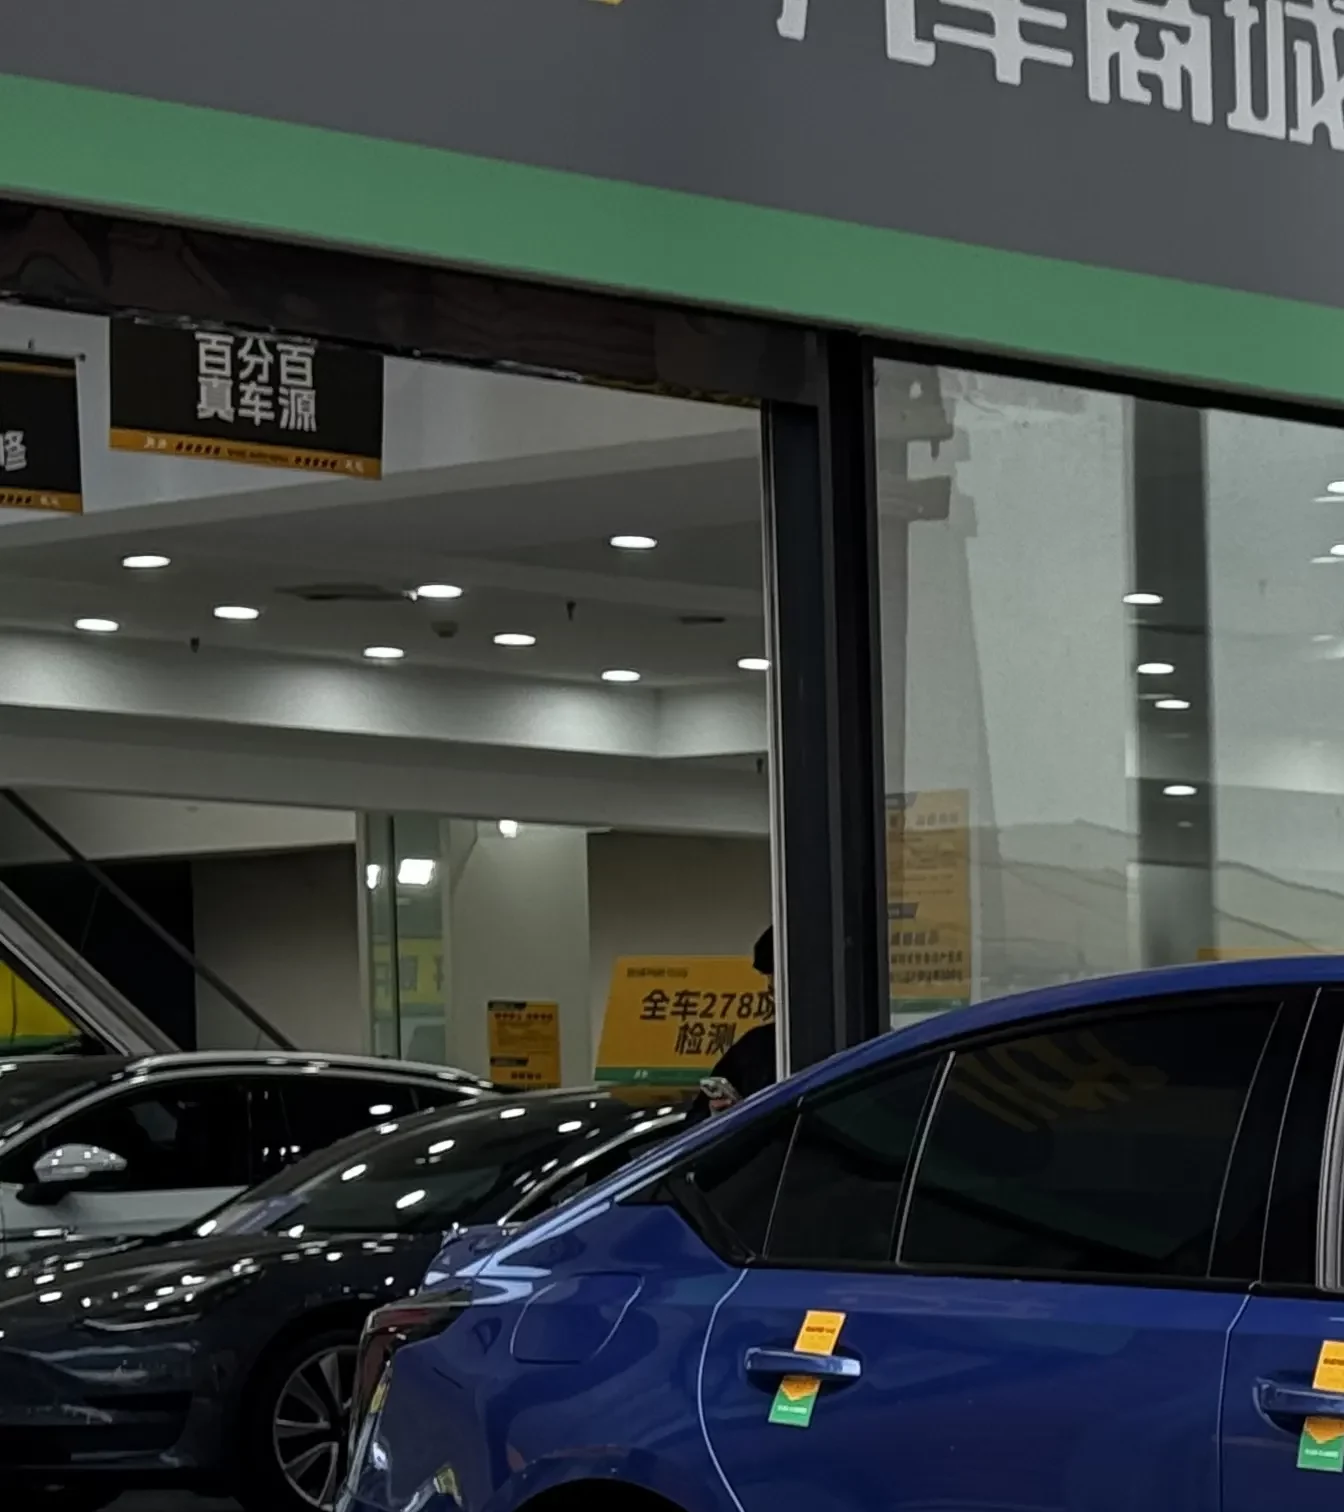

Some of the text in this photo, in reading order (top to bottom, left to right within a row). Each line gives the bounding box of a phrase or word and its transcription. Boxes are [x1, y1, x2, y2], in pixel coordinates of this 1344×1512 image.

[194, 331, 318, 388] 百分百
[196, 374, 317, 432] 真车源
[674, 1022, 738, 1057] 检测
